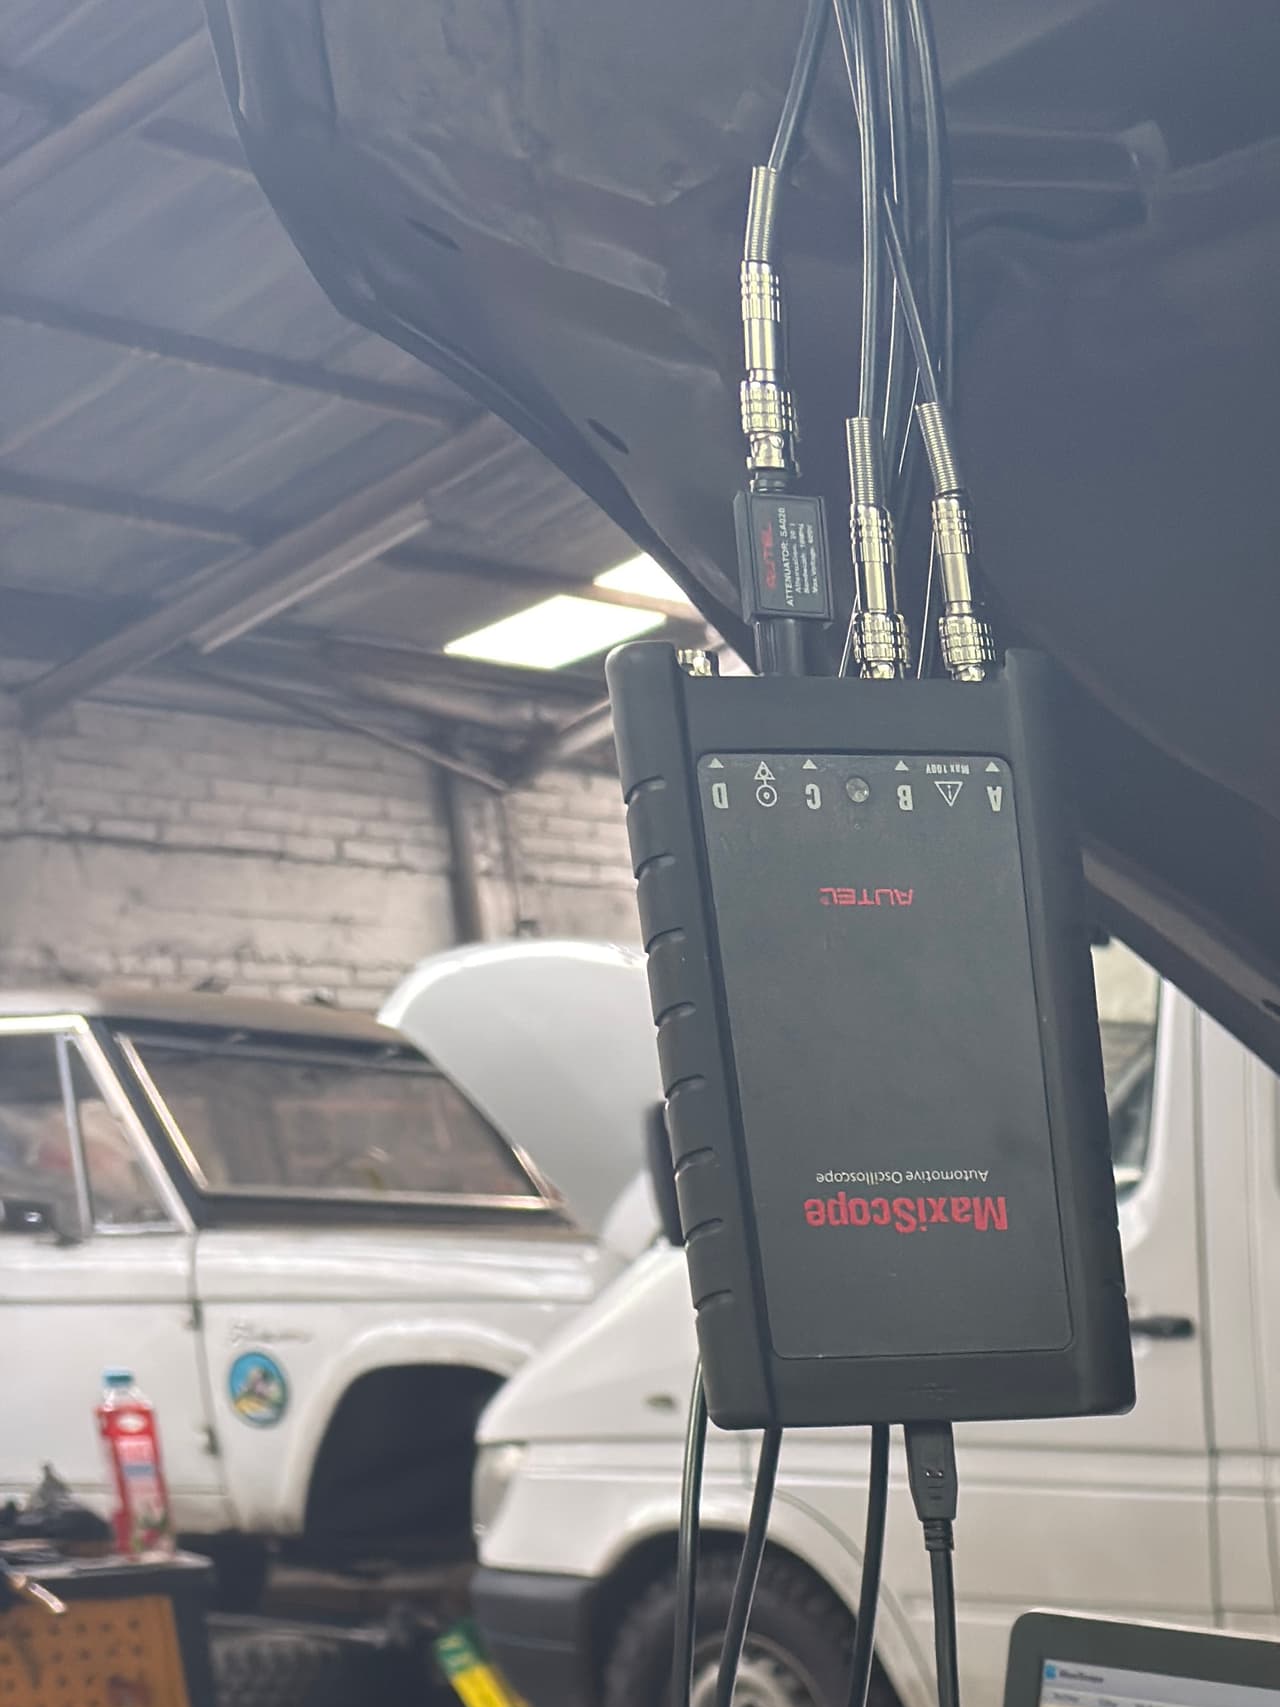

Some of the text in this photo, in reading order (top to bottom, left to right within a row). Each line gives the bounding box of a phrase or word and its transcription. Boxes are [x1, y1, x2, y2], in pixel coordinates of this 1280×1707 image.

[711, 782, 729, 809] D
[805, 783, 821, 810] C
[896, 784, 913, 811] B
[986, 786, 1002, 812] A
[819, 887, 914, 907] AUTEL
[816, 1169, 988, 1185] Automotive Oscilloscope
[803, 1191, 1009, 1235] MaxiScope
